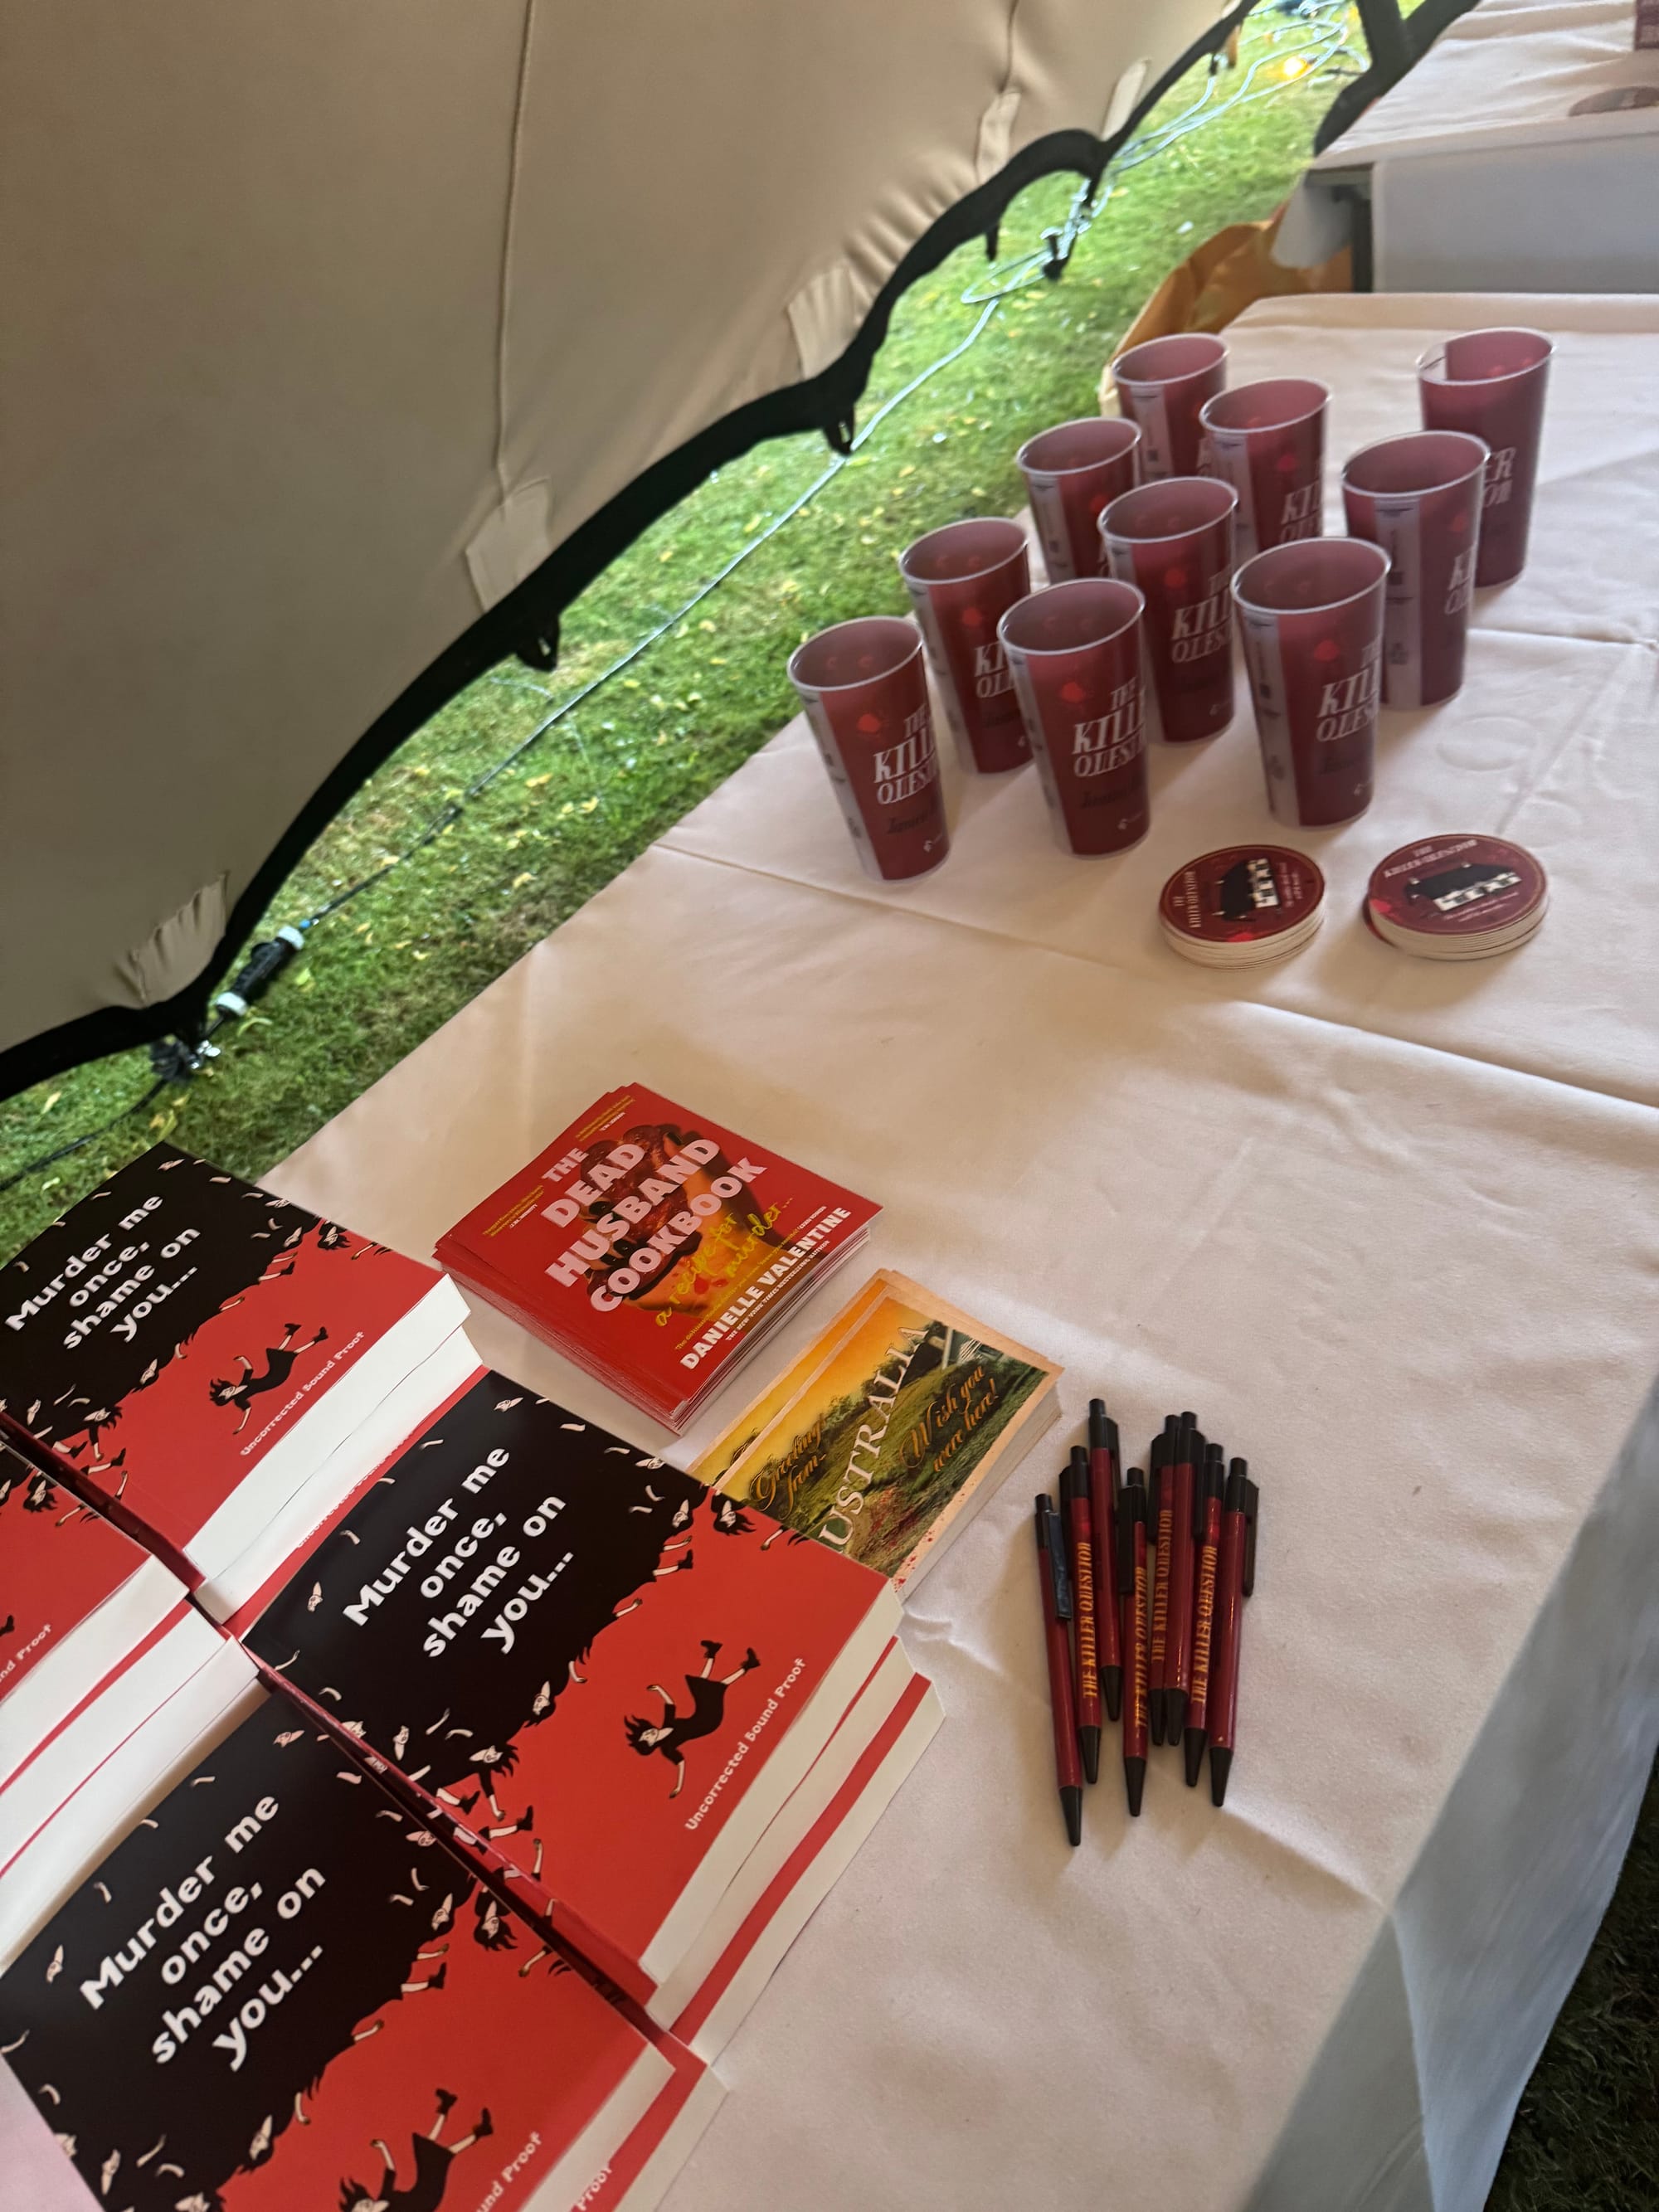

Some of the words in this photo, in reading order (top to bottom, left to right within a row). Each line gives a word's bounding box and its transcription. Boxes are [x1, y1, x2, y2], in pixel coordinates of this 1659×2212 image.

[541, 1148, 589, 1182] THE
[541, 1144, 645, 1228] DEAD
[544, 1139, 720, 1287] HUSBAND
[4, 1233, 112, 1331] Murder
[118, 1196, 163, 1231] me
[63, 1265, 155, 1349] shame
[160, 1228, 201, 1258] on
[69, 1242, 150, 1307] once,
[591, 1157, 767, 1312] COOKBOOK
[680, 1286, 765, 1369] DANIELLE
[757, 1208, 852, 1286] VALENTINE
[110, 1266, 197, 1343] you...
[240, 1391, 304, 1456] Uncorrected
[302, 1360, 336, 1392] Bound
[333, 1331, 365, 1360] Proof
[819, 1327, 929, 1553] USTRALIA
[900, 1383, 957, 1468] Wish
[959, 1365, 985, 1415] you
[933, 1429, 963, 1472] were
[343, 1498, 459, 1626] Murder
[461, 1448, 510, 1494] me
[420, 1512, 508, 1598] once,
[423, 1546, 521, 1658] shame
[523, 1496, 567, 1538] on
[1078, 1542, 1094, 1612] QUESTION
[480, 1552, 574, 1655] you...
[684, 1741, 750, 1830] Uncorrected
[744, 1698, 779, 1743] Bound
[774, 1657, 807, 1699] Proof
[80, 1855, 216, 2010] Murder
[225, 1796, 279, 1854] me
[161, 1882, 264, 1986] once,
[152, 1928, 270, 2064] shame
[277, 1868, 326, 1919] on
[212, 1945, 324, 2073] you...
[501, 2132, 541, 2183] Proof
